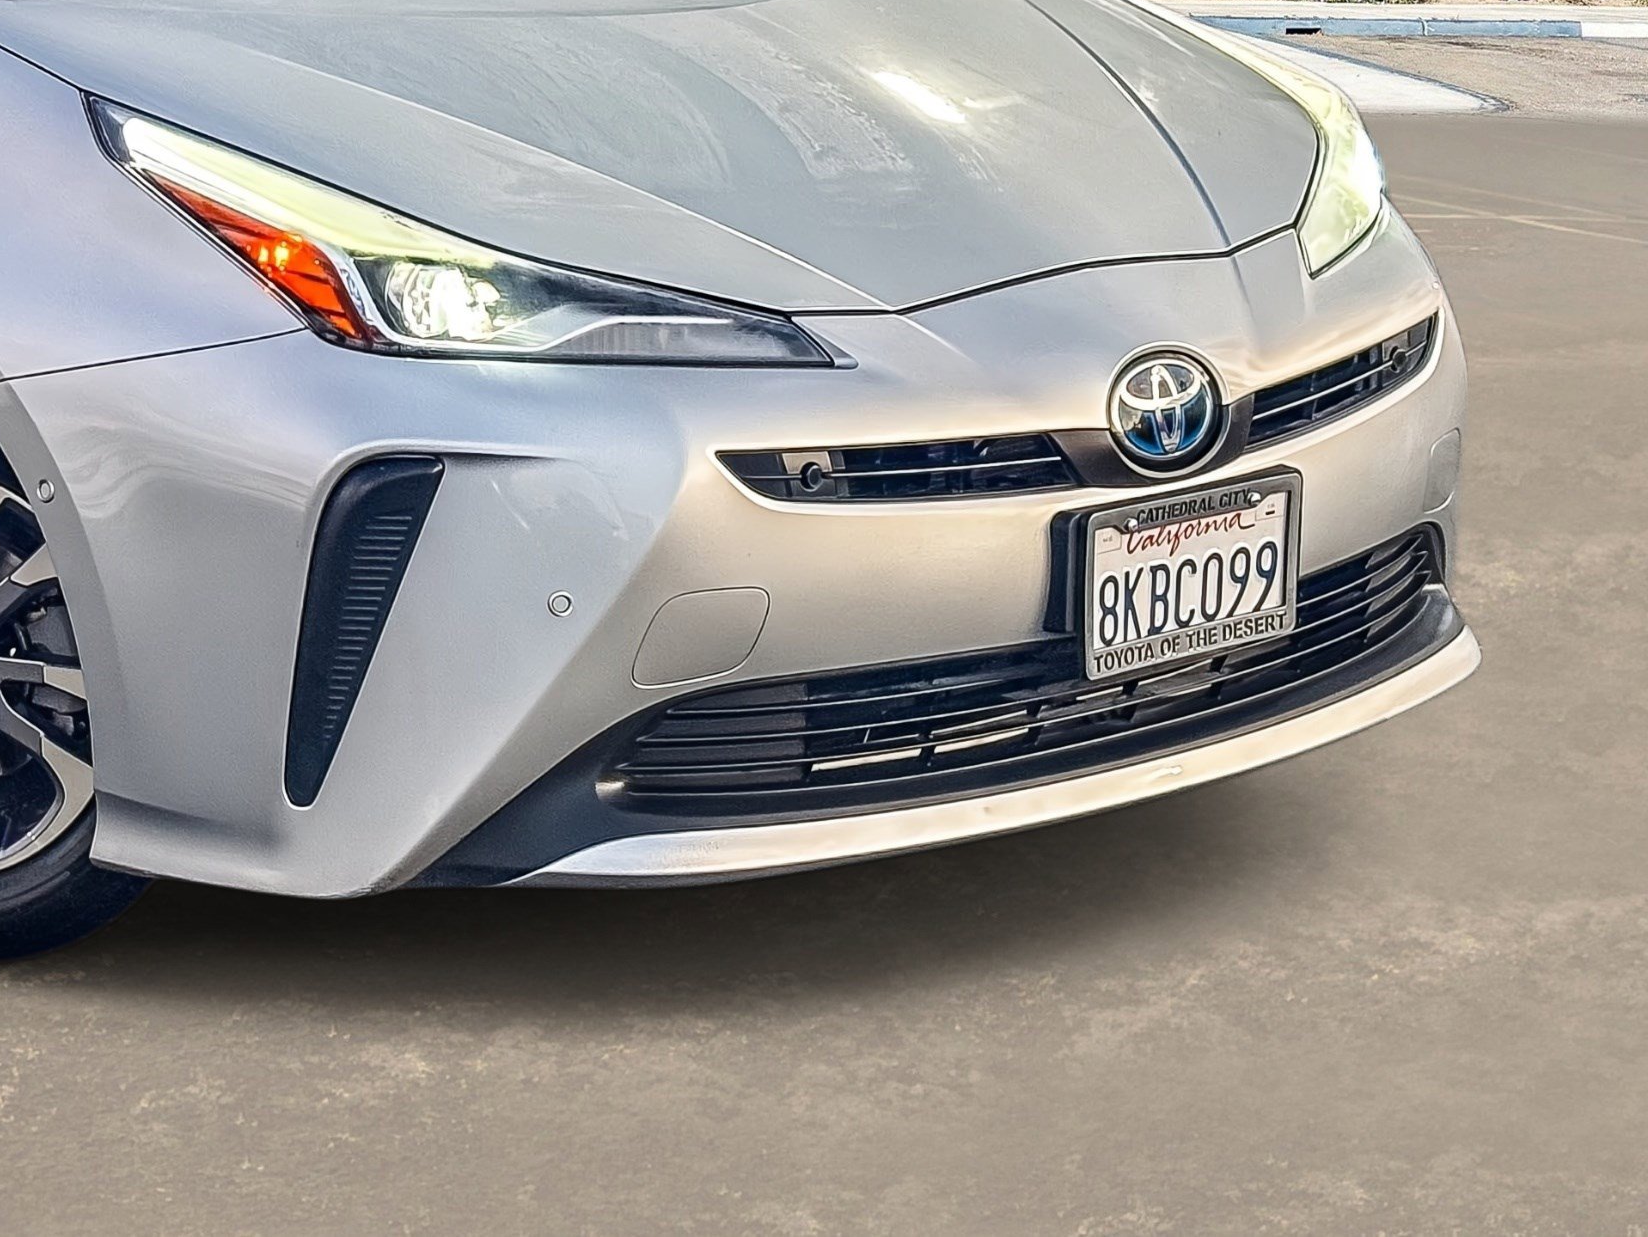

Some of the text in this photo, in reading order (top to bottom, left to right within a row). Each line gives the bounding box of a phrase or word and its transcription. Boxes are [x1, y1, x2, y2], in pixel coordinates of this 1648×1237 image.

[1136, 488, 1251, 526] CATHEDRAL CITY
[1126, 513, 1256, 558] California
[1099, 540, 1279, 646] 8KBC099
[1094, 612, 1287, 673] TOYOTA OF THE DESERT
